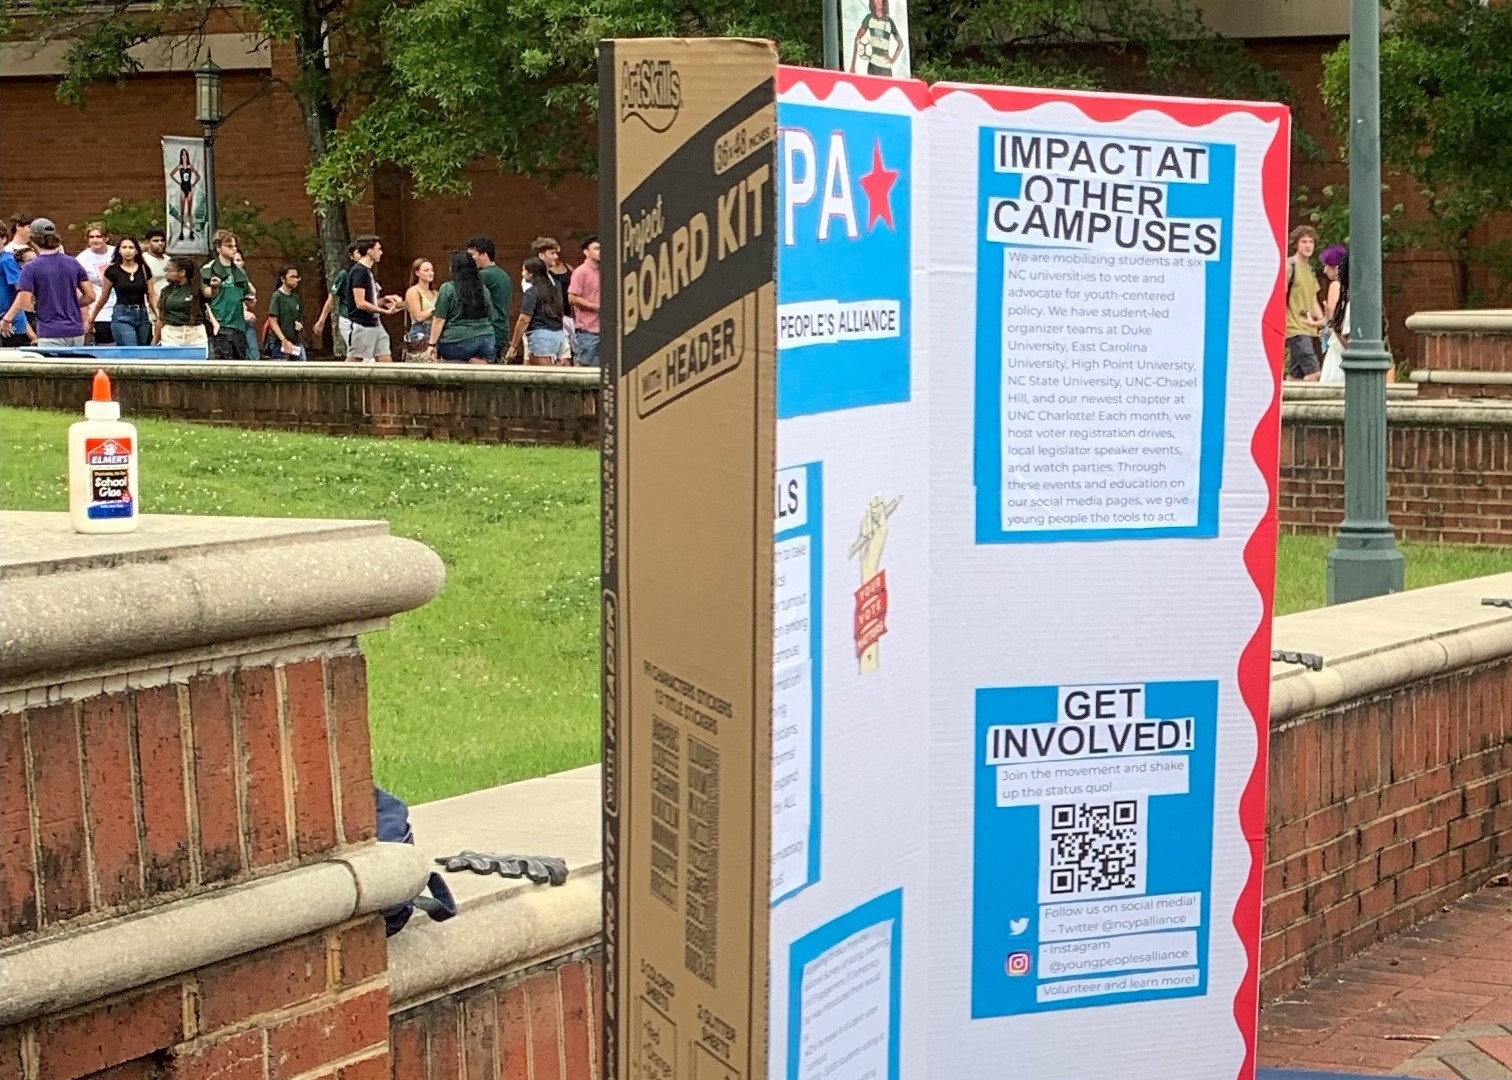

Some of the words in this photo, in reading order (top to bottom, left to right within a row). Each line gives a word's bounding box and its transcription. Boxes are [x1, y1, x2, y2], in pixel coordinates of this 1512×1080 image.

[621, 60, 681, 109] ArtSkills
[1000, 135, 1152, 177] IMPACT
[1156, 146, 1206, 179] AT
[1024, 175, 1164, 218] OTHER
[623, 194, 665, 263] Project
[993, 200, 1217, 255] CAMPUSES
[624, 212, 709, 336] BOARD
[717, 163, 769, 261] KIT
[1009, 252, 1027, 262] We
[1031, 254, 1049, 262] are
[1053, 253, 1115, 267] mobilizing
[1118, 256, 1170, 267] students
[1173, 257, 1184, 267] at
[1187, 258, 1202, 268] six
[1008, 270, 1026, 280] NC
[1029, 271, 1097, 282] universities
[1100, 273, 1111, 282] to
[1114, 273, 1140, 283] vote
[1142, 273, 1165, 284] and
[1008, 288, 1062, 299] advocate
[1065, 289, 1081, 299] for
[1084, 290, 1175, 301] youth-centered
[1048, 306, 1067, 316] We
[1071, 306, 1098, 317] have
[1101, 307, 1169, 318] student-led
[780, 312, 835, 338] PEOPLE'S
[838, 309, 895, 333] ALLIANCE
[1008, 324, 1063, 336] organizer
[1067, 325, 1103, 335] teams
[1106, 325, 1118, 335] at
[1121, 325, 1152, 336] Duke
[666, 317, 735, 391] HEADER
[1008, 340, 1069, 354] University,
[1072, 342, 1096, 352] East
[1099, 342, 1148, 353] Carolina
[1008, 358, 1068, 371] University,
[1072, 359, 1100, 371] High
[1103, 359, 1133, 370] Point
[1137, 360, 1197, 372] University,
[1008, 376, 1026, 386] NC
[1029, 376, 1059, 386] State
[1062, 376, 1122, 388] University,
[1125, 377, 1197, 388] UNC-Chapel
[1008, 393, 1030, 404] Hill,
[1033, 393, 1055, 404] and
[1058, 395, 1077, 404] our
[1081, 394, 1123, 404] newest
[1126, 394, 1170, 406] chapter
[1173, 395, 1184, 404] at
[1008, 411, 1035, 421] UNC
[1038, 411, 1095, 421] Charlotte!
[1099, 411, 1126, 421] Each
[1130, 411, 1172, 422] month,
[1175, 413, 1192, 421] we
[1008, 428, 1032, 438] host
[1036, 429, 1066, 438] voter
[1070, 428, 1135, 440] registration
[1139, 428, 1175, 439] drives,
[1008, 445, 1034, 455] local
[1038, 445, 1091, 457] legislator
[1094, 445, 1139, 457] speaker
[1142, 445, 1182, 456] events,
[91, 455, 127, 464] ELMER'S
[1008, 463, 1030, 473] and
[1033, 462, 1068, 472] watch
[1118, 462, 1166, 473] Through
[95, 477, 127, 487] School
[1008, 480, 1040, 490] these
[1043, 480, 1081, 489] events
[1084, 479, 1106, 489] and
[1109, 478, 1167, 489] education
[1170, 480, 1185, 488] on
[1008, 499, 1027, 507] our
[1031, 496, 1062, 506] social
[1066, 496, 1103, 506] media
[1106, 497, 1142, 508] pages,
[1145, 496, 1162, 505] we
[1165, 495, 1189, 507] give
[1007, 515, 1045, 526] young
[1048, 513, 1088, 524] people
[1091, 513, 1109, 522] the
[1113, 512, 1140, 522] tools
[1143, 513, 1154, 522] to
[860, 576, 881, 599] YOUR
[859, 602, 882, 624] VOTE
[604, 601, 616, 742] HEADER
[1064, 688, 1141, 721] GET
[993, 719, 1191, 758] INVOLVED!
[1002, 770, 1027, 781] Join
[1031, 769, 1051, 779] the
[1055, 765, 1120, 778] movement
[1124, 763, 1147, 773] and
[1150, 760, 1185, 772] shake
[1003, 790, 1019, 800] up
[1022, 787, 1042, 797] the
[1045, 785, 1083, 796] status
[1086, 783, 1112, 795] quo!
[1045, 906, 1083, 918] Follow
[1086, 906, 1100, 915] us
[1102, 904, 1117, 913] on
[1121, 900, 1153, 911] social
[1156, 897, 1196, 908] media!
[1058, 921, 1099, 934] Twitter
[1102, 914, 1186, 932] @ncypalliance
[1050, 940, 1110, 955] Instagram
[1050, 949, 1189, 973] @youngpeoplesalliance
[1043, 983, 1101, 996] Volunteer
[1104, 980, 1127, 991] and
[1130, 977, 1159, 989] learn
[1162, 974, 1195, 985] more!
